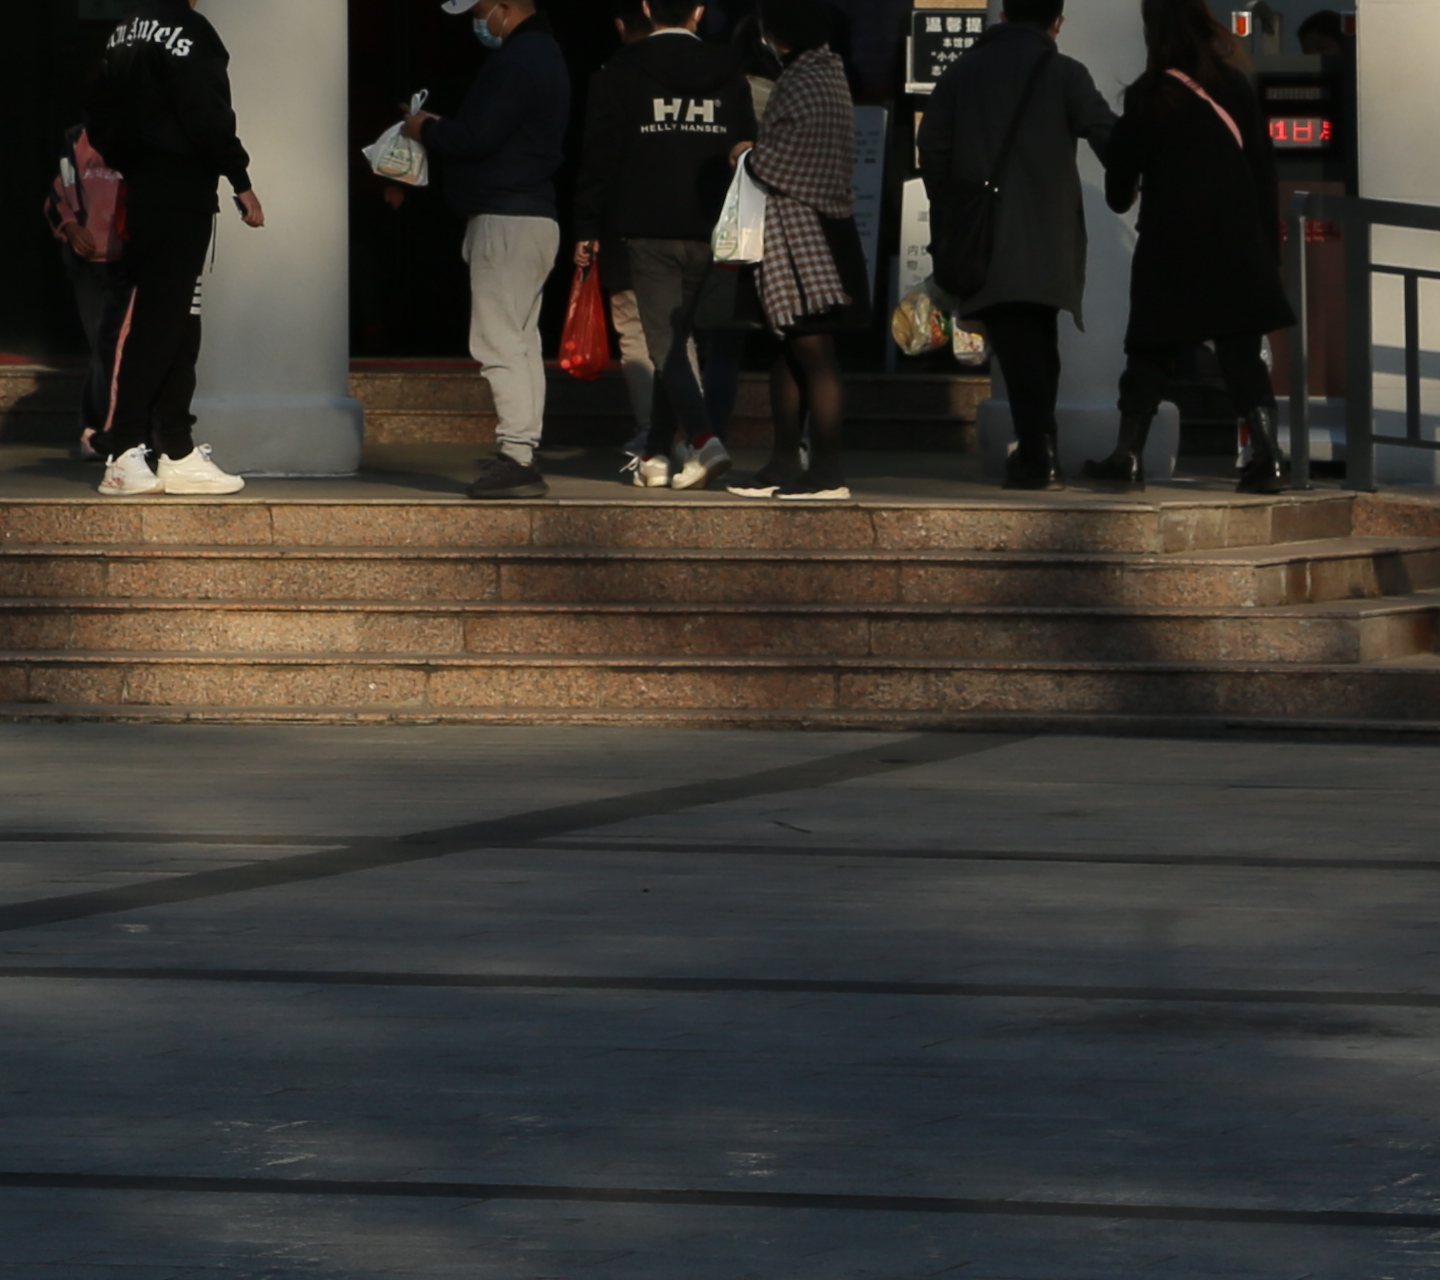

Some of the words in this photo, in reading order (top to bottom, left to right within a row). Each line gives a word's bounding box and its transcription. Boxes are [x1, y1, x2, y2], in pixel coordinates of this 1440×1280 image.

[926, 17, 982, 33] 温馨提
[640, 123, 677, 133] HELLY
[681, 124, 727, 134] HANSEN
